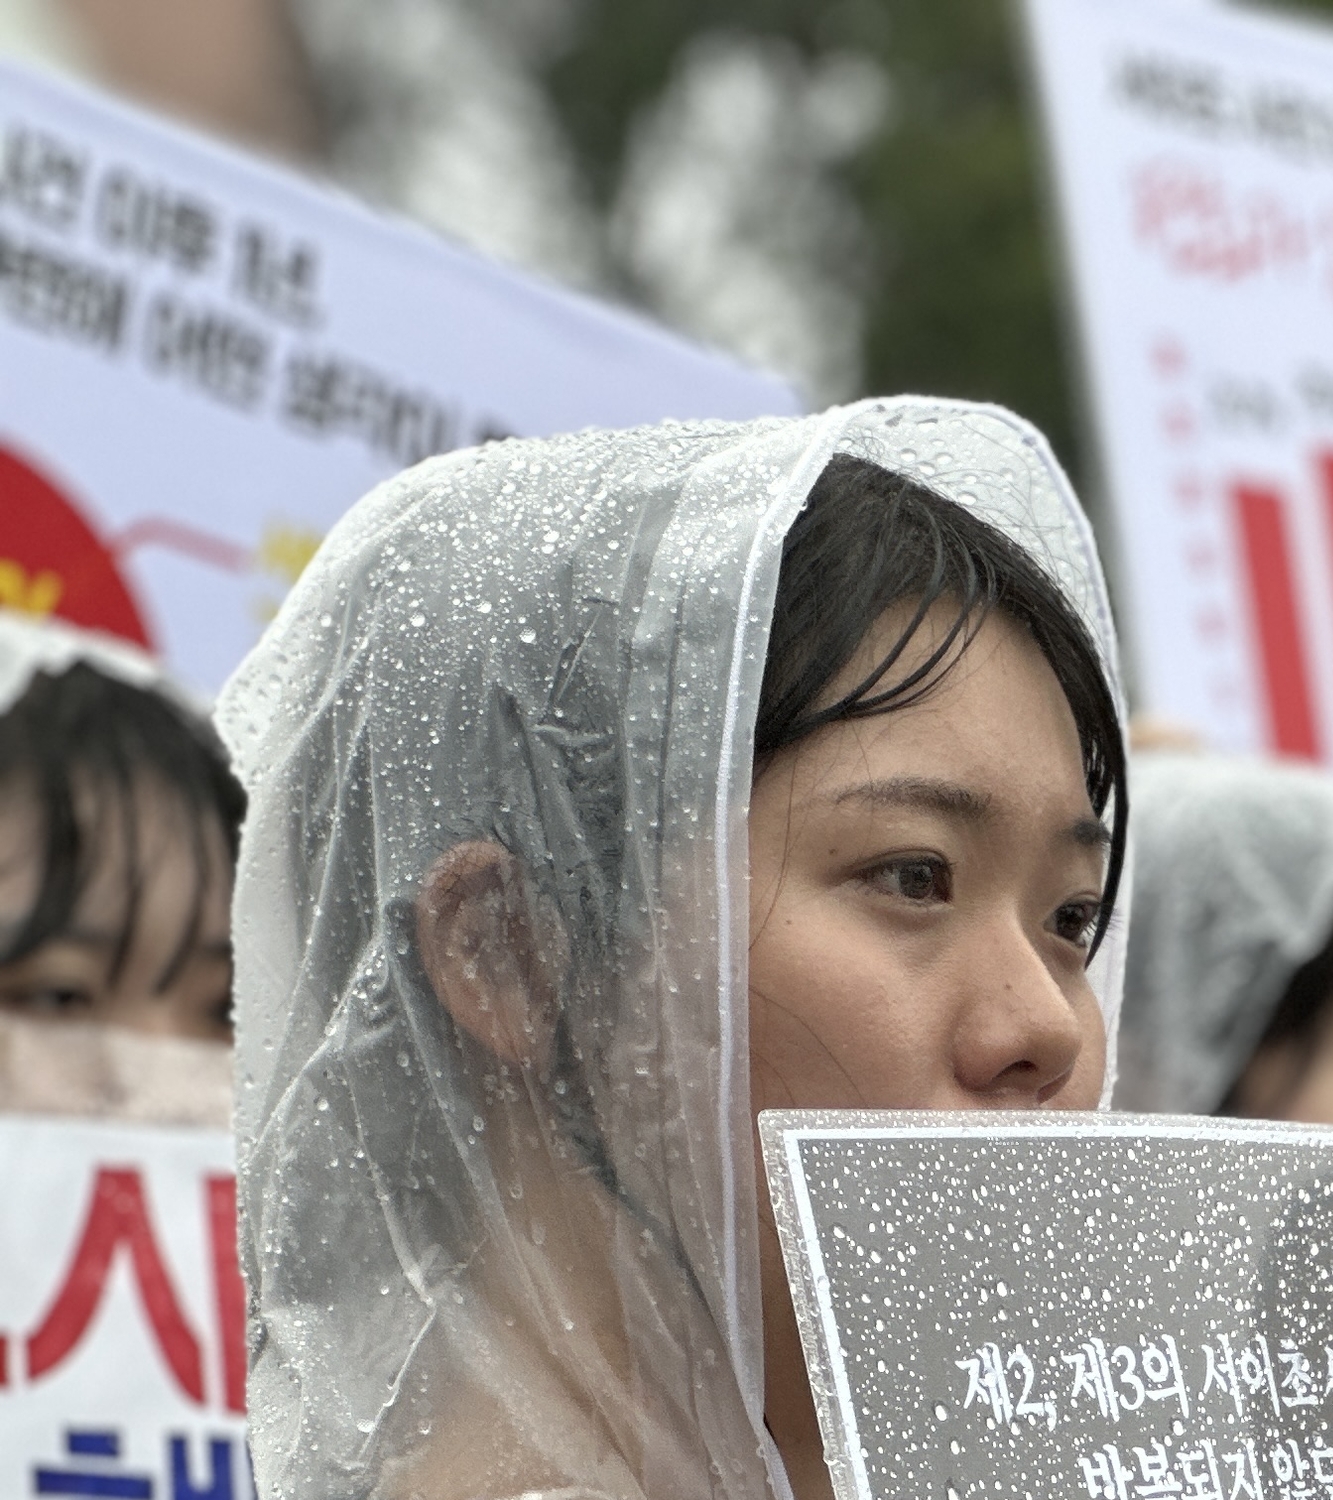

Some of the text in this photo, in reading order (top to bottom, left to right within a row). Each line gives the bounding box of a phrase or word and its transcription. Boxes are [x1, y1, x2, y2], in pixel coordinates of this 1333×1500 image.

[0, 1162, 247, 1414] 사
[954, 1341, 1057, 1432] 제2,
[1062, 1333, 1190, 1421] 제3의
[1201, 1333, 1319, 1418] 서이초
